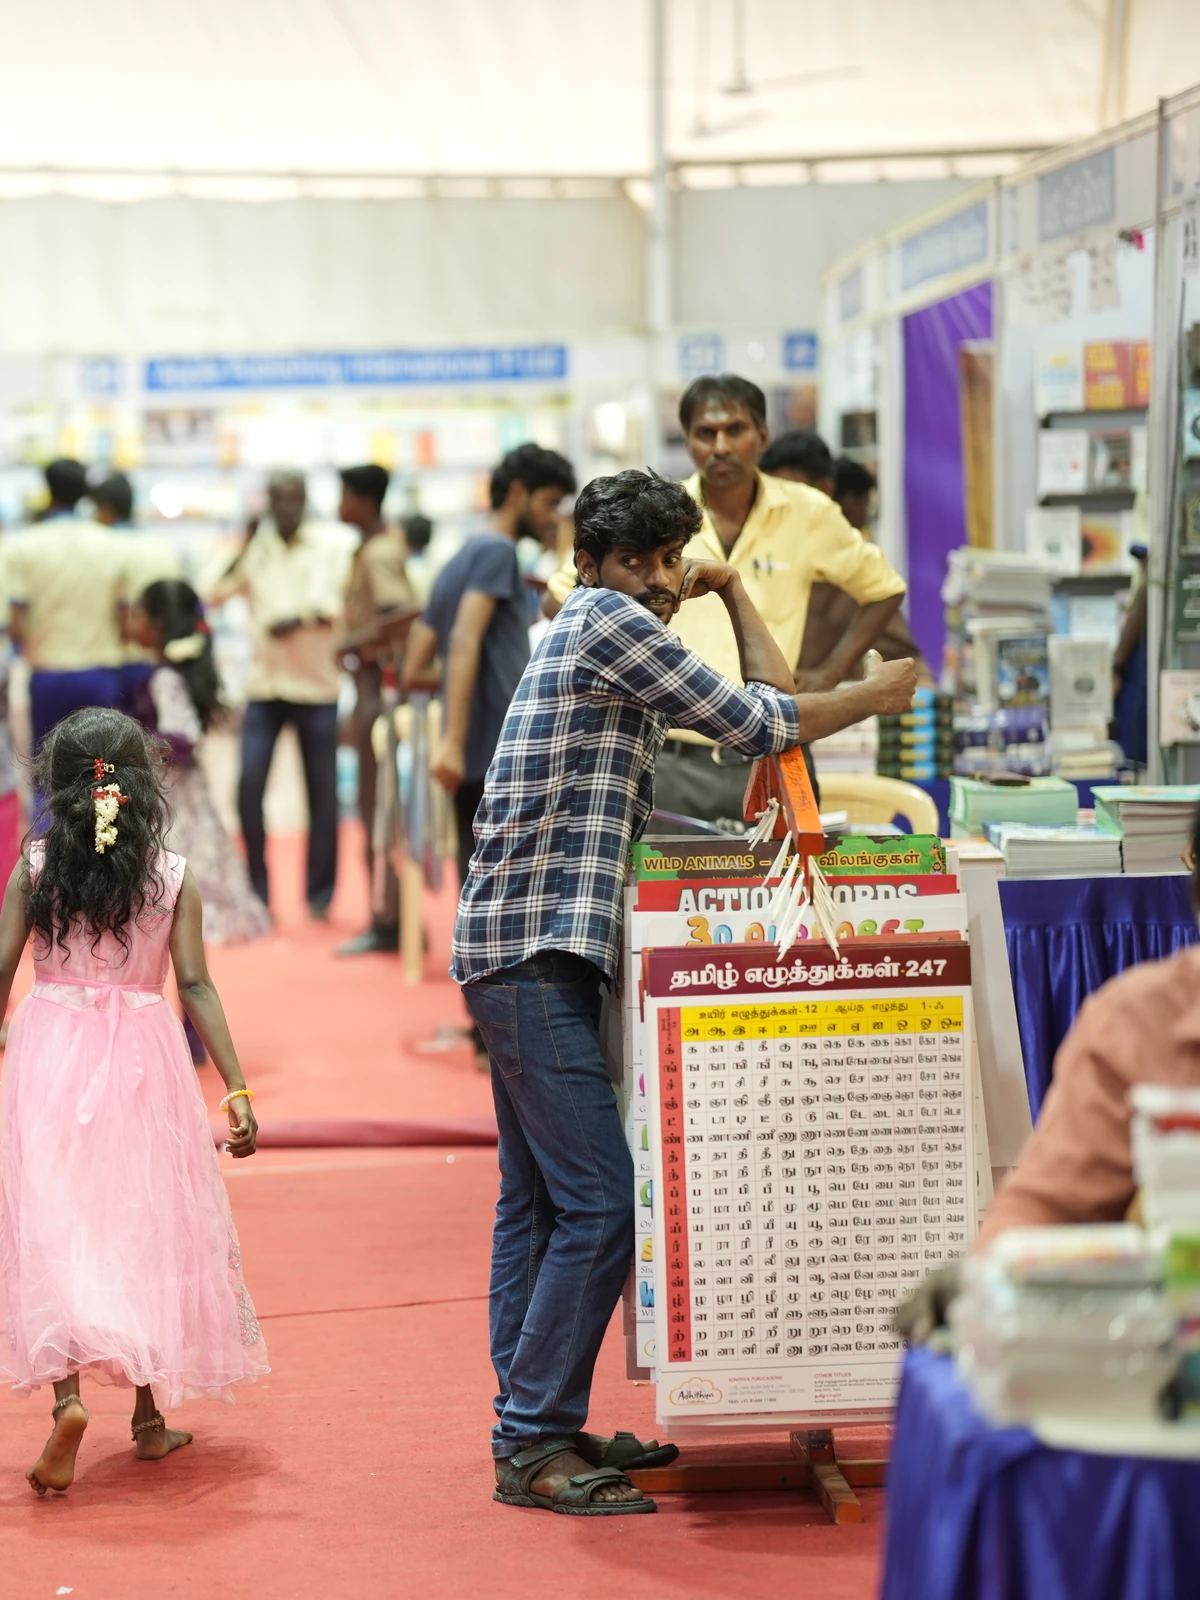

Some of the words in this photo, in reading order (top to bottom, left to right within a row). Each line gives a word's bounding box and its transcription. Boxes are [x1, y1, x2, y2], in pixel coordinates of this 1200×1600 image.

[643, 857, 682, 871] WILD
[684, 855, 755, 870] ANIMALS
[818, 850, 921, 868] விலங்குகள்
[677, 885, 788, 912] ACTIO
[745, 919, 925, 944] ALABET
[668, 961, 739, 991] தமிழ்
[684, 1027, 699, 1036] அ
[708, 1026, 726, 1037] ஆ
